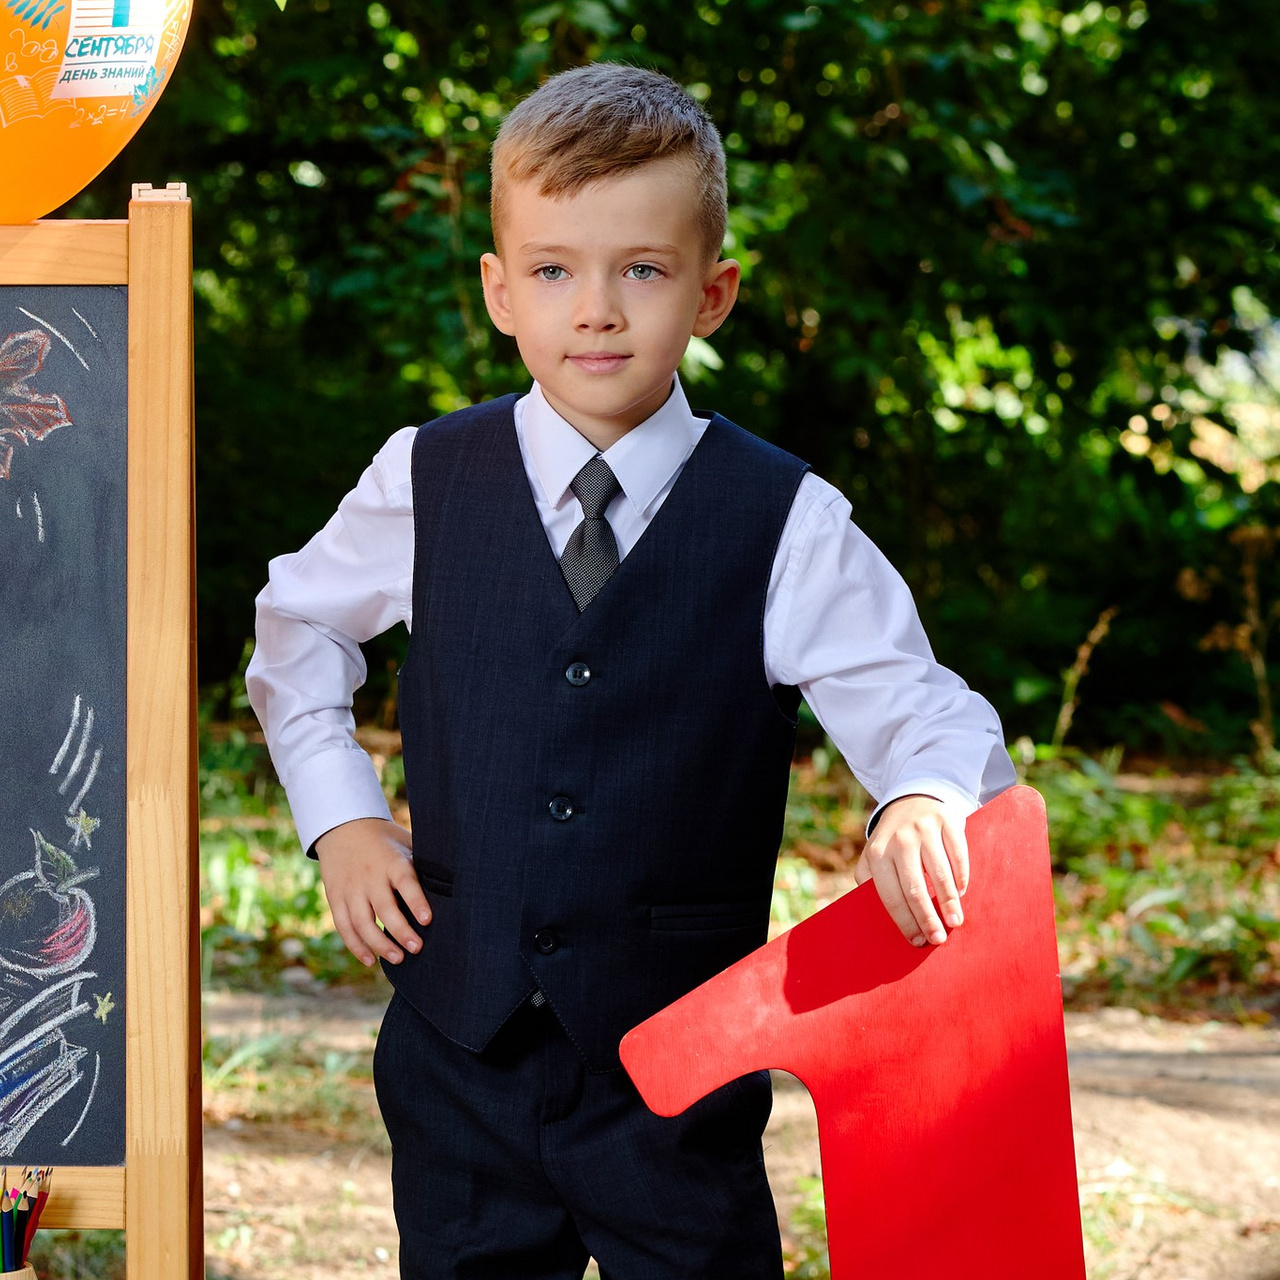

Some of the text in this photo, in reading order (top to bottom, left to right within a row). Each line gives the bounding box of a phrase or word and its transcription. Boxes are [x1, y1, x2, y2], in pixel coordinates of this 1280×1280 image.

[64, 35, 155, 58] СЕНТЯБРЯ
[59, 65, 146, 84] ДЕНЬ ЗНАНИЙ
